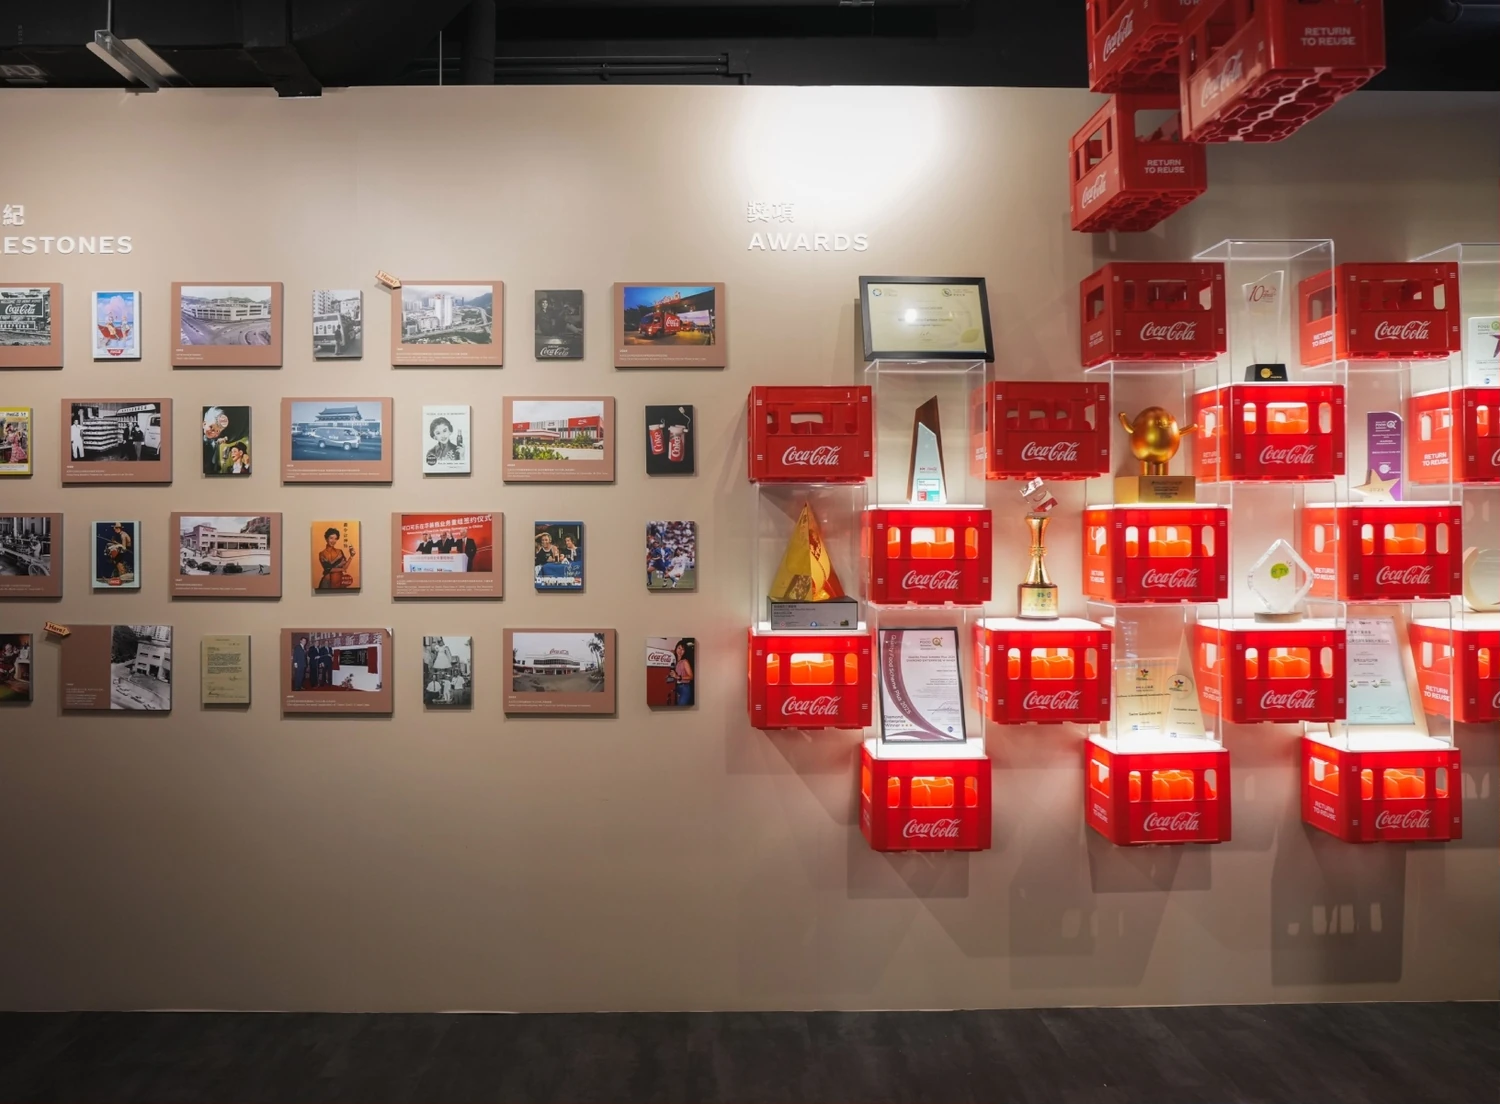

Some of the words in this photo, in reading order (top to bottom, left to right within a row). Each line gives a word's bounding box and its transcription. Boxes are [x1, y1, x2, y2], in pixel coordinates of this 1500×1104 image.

[1103, 10, 1133, 61] Coca-Cola
[1301, 37, 1314, 46] TO
[1318, 36, 1356, 46] REUSE
[1304, 27, 1352, 36] RETURN
[1201, 50, 1244, 108] Coca-Cola
[1144, 166, 1156, 174] TO
[1159, 166, 1185, 174] REUSE
[1147, 159, 1181, 167] RETURN
[2, 204, 25, 226] 紀
[747, 201, 796, 223] 獎項
[748, 233, 869, 252] AWARDS
[1140, 321, 1198, 341] Coca-Cola
[1374, 320, 1430, 340] Coca-Cola
[782, 446, 842, 466] Coca-Cola
[1020, 441, 1078, 463] Coca-Cola
[1259, 445, 1317, 465] Coca-Cola
[902, 570, 962, 590] Coca-Cola
[1141, 568, 1200, 589] Coca-Cola
[1376, 565, 1433, 585] Coca-Cola
[781, 696, 841, 716] Coca-Cola
[1023, 690, 1081, 710] Coca-Cola
[1260, 690, 1318, 710] Coca-Cola
[902, 819, 962, 839] Coca-Cola
[1143, 811, 1201, 831] Coca-Cola
[1375, 810, 1432, 829] Coca-Cola
